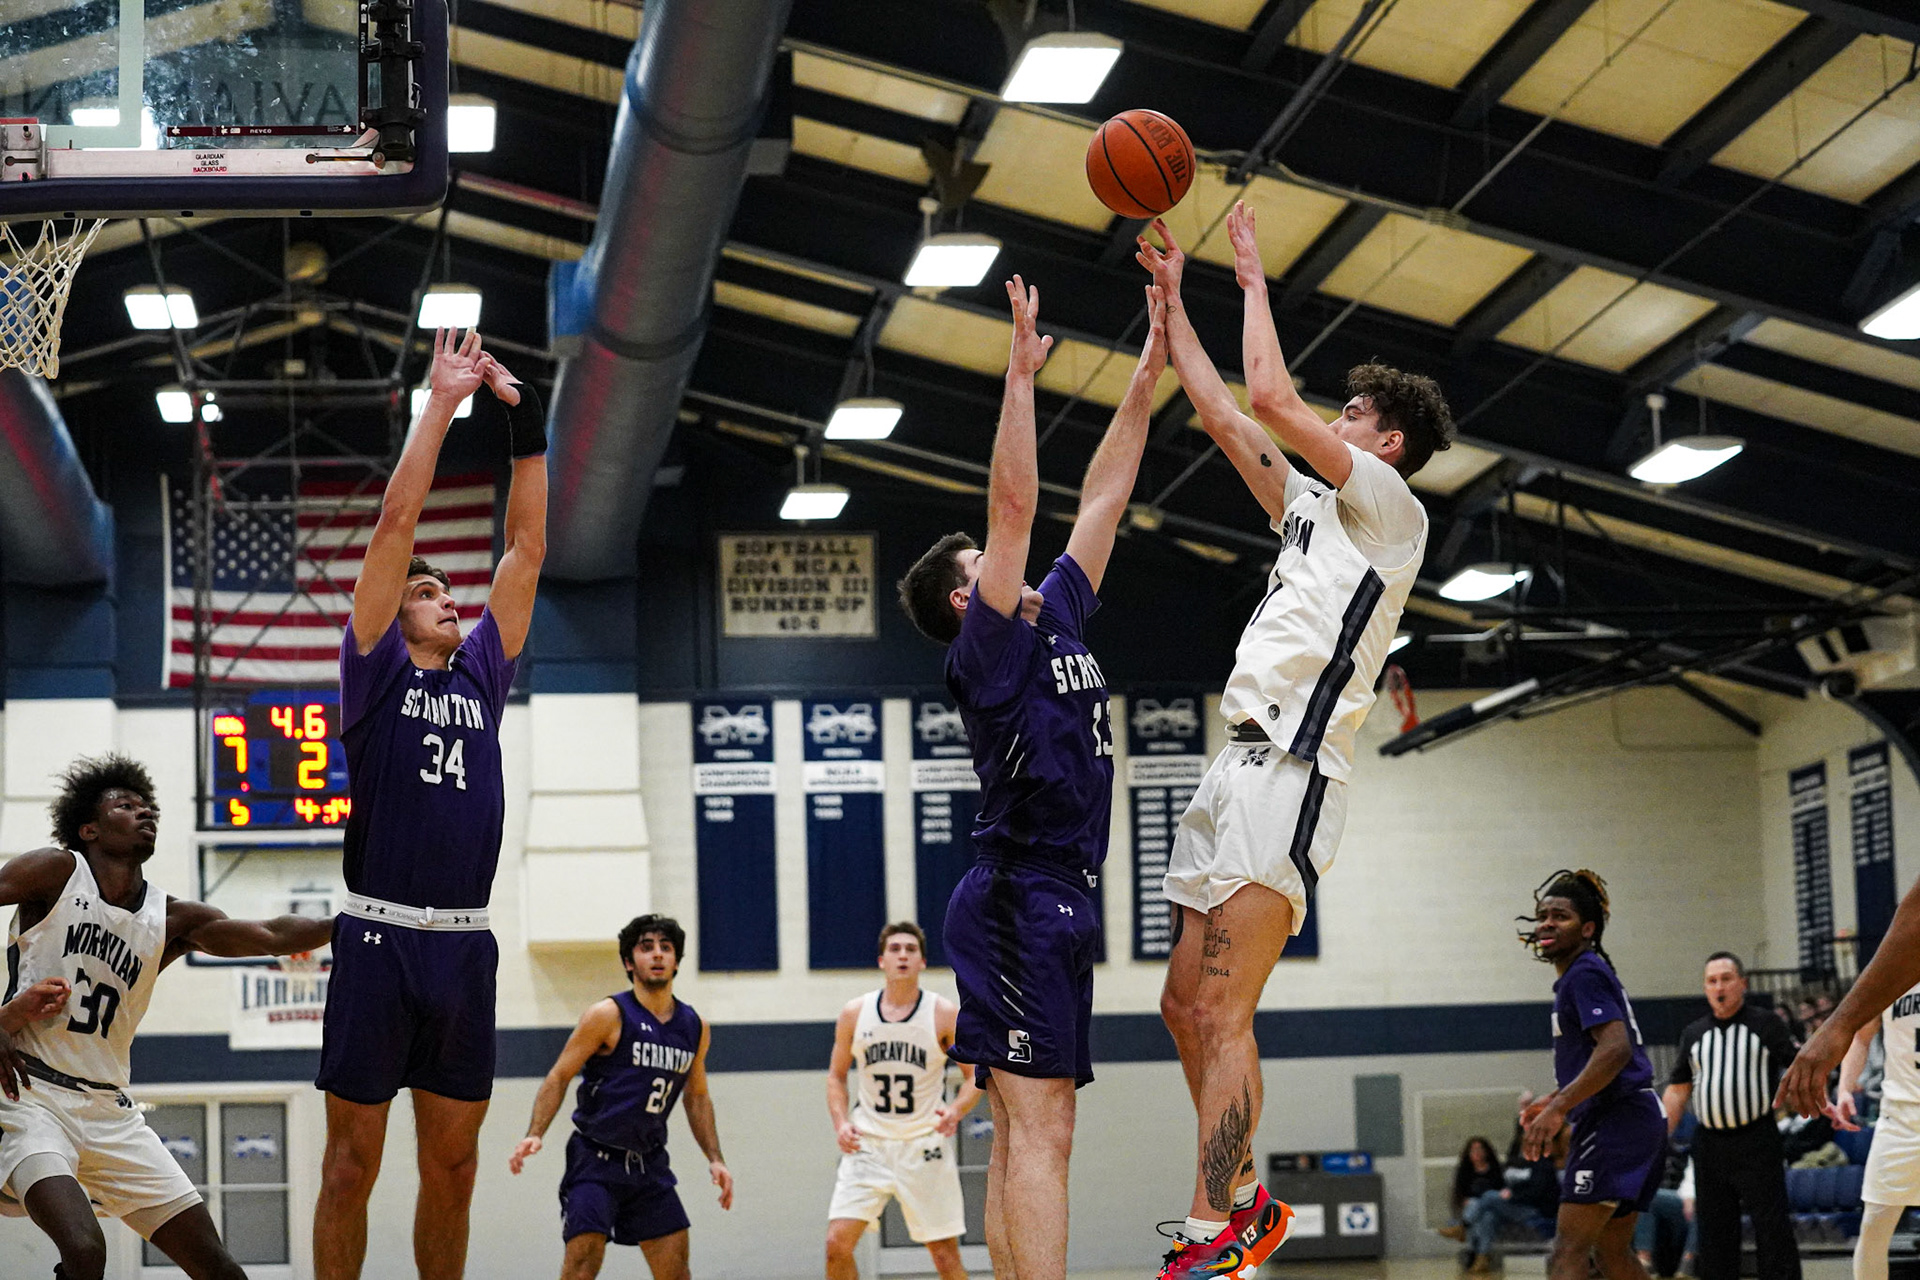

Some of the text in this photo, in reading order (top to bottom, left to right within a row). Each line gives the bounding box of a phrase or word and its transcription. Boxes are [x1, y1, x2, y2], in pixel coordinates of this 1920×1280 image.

[1165, 152, 1186, 184] THE
[735, 540, 858, 555] SOFTBALL
[793, 559, 861, 574] NCAA
[727, 577, 869, 593] DIVISION III
[731, 596, 865, 612] RUNNER-UP
[270, 703, 327, 740] 4.6
[400, 687, 485, 731] SCRANTON
[223, 736, 248, 774] 7
[298, 740, 328, 790] 2
[419, 732, 467, 791] 34
[61, 921, 143, 992] MORAVIAN
[66, 966, 121, 1040] 30
[632, 1041, 696, 1074] SCRANTON
[864, 1040, 928, 1070] MORAVIAN
[1007, 1029, 1032, 1064] S
[645, 1077, 675, 1114] 21
[873, 1073, 915, 1114] 33
[1574, 1169, 1595, 1195] S
[1241, 1224, 1258, 1246] 13
